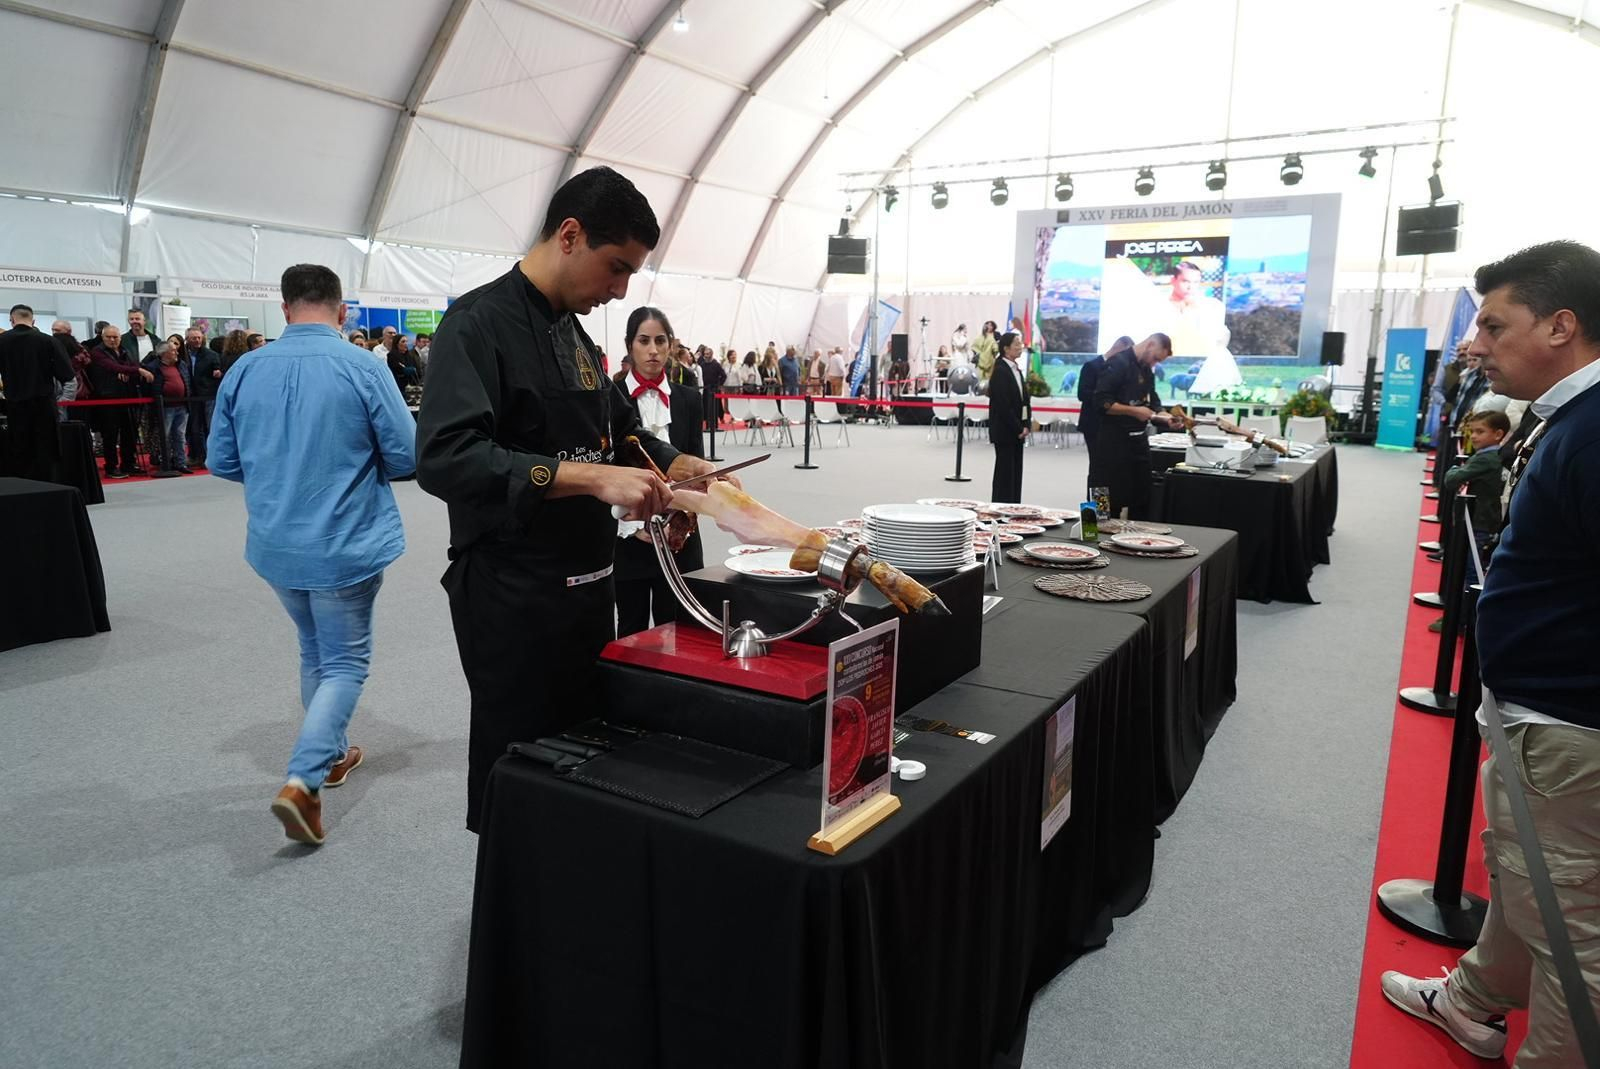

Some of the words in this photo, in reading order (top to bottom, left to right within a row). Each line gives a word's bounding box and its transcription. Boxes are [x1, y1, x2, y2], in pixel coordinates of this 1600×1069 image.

[1079, 209, 1104, 222] XXV
[1110, 206, 1149, 220] FERIA
[1152, 204, 1178, 218] DEL
[0, 274, 42, 283] LOTERRA
[43, 276, 102, 286] DELICATESSEN
[865, 684, 872, 700] 9
